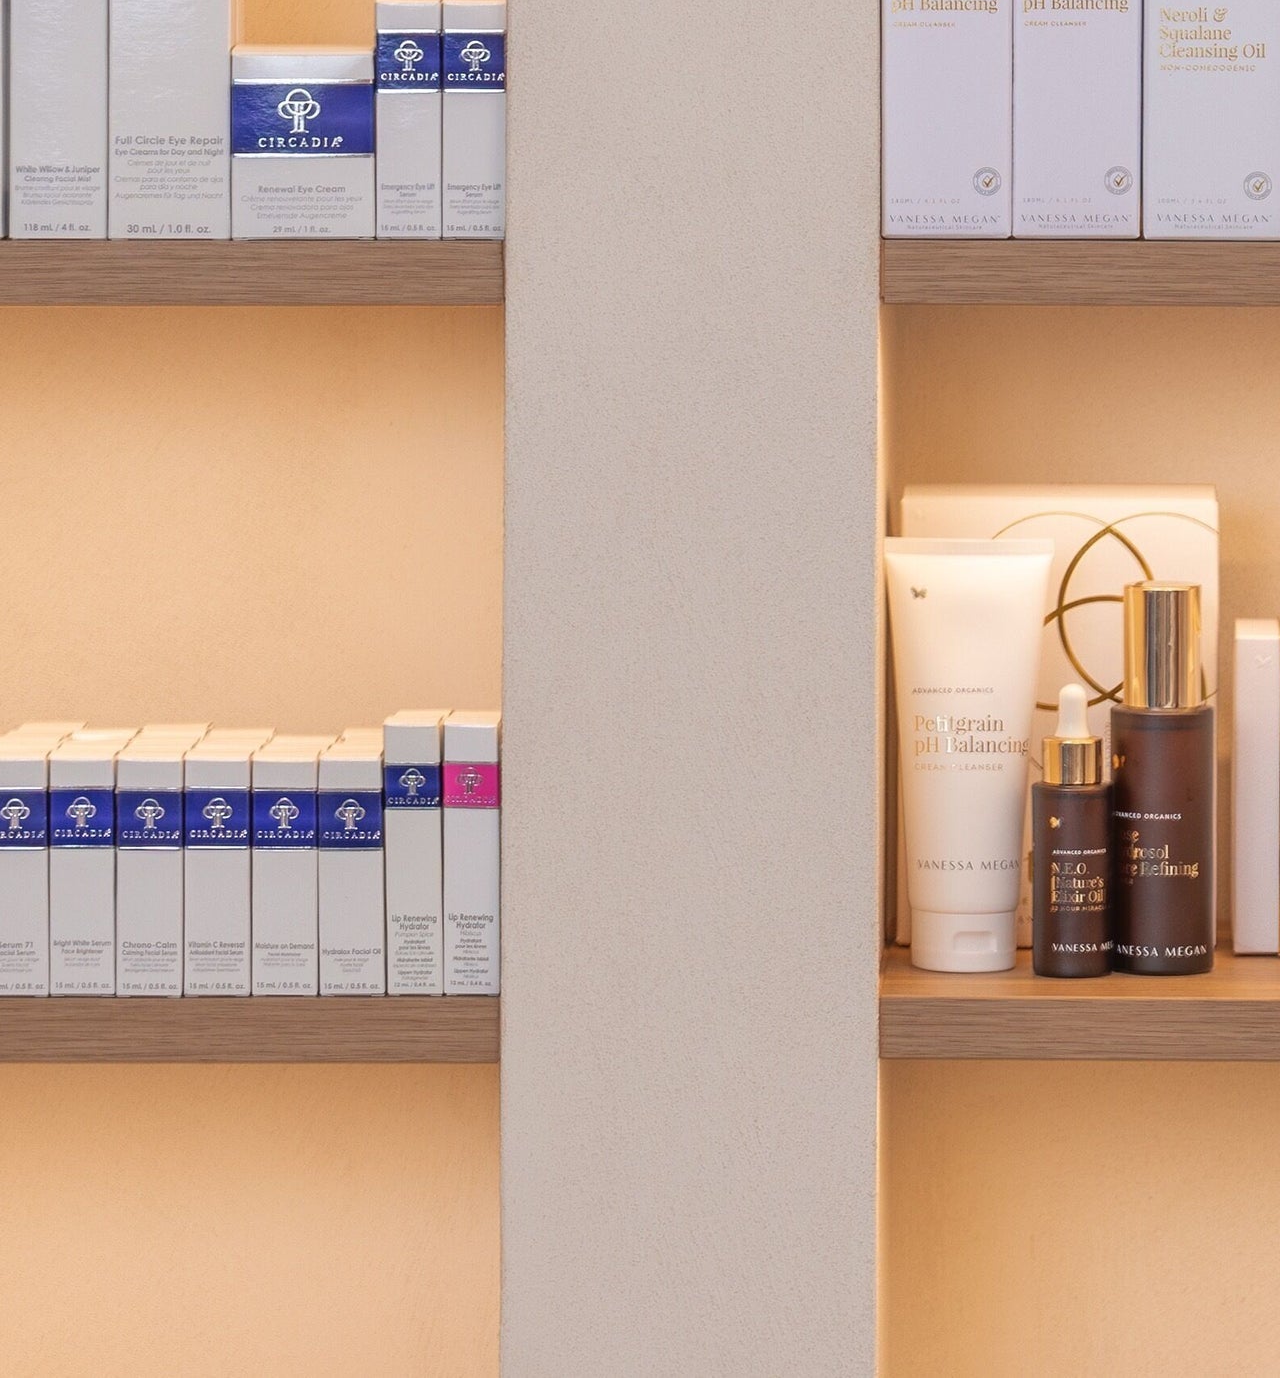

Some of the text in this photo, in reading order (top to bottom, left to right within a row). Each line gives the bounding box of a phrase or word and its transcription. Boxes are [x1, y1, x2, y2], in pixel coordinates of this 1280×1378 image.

[1160, 7, 1229, 22] Neroli &
[1160, 26, 1231, 43] Squalane
[1159, 43, 1266, 61] Cleansing Oil
[115, 136, 224, 147] Full Circle Eye Repair
[258, 185, 346, 195] Renewal Eye Cream
[914, 715, 1004, 735] Petitgrain
[914, 735, 1029, 756] pH Balancing
[1139, 861, 1199, 878] Refining
[392, 915, 437, 924] Lip Renewing
[448, 914, 494, 923] Lip Renewing
[399, 923, 430, 931] Hydrator
[456, 922, 486, 930] Hydrator
[1052, 942, 1098, 952] VANESSA
[1165, 945, 1207, 957] MEGAN
